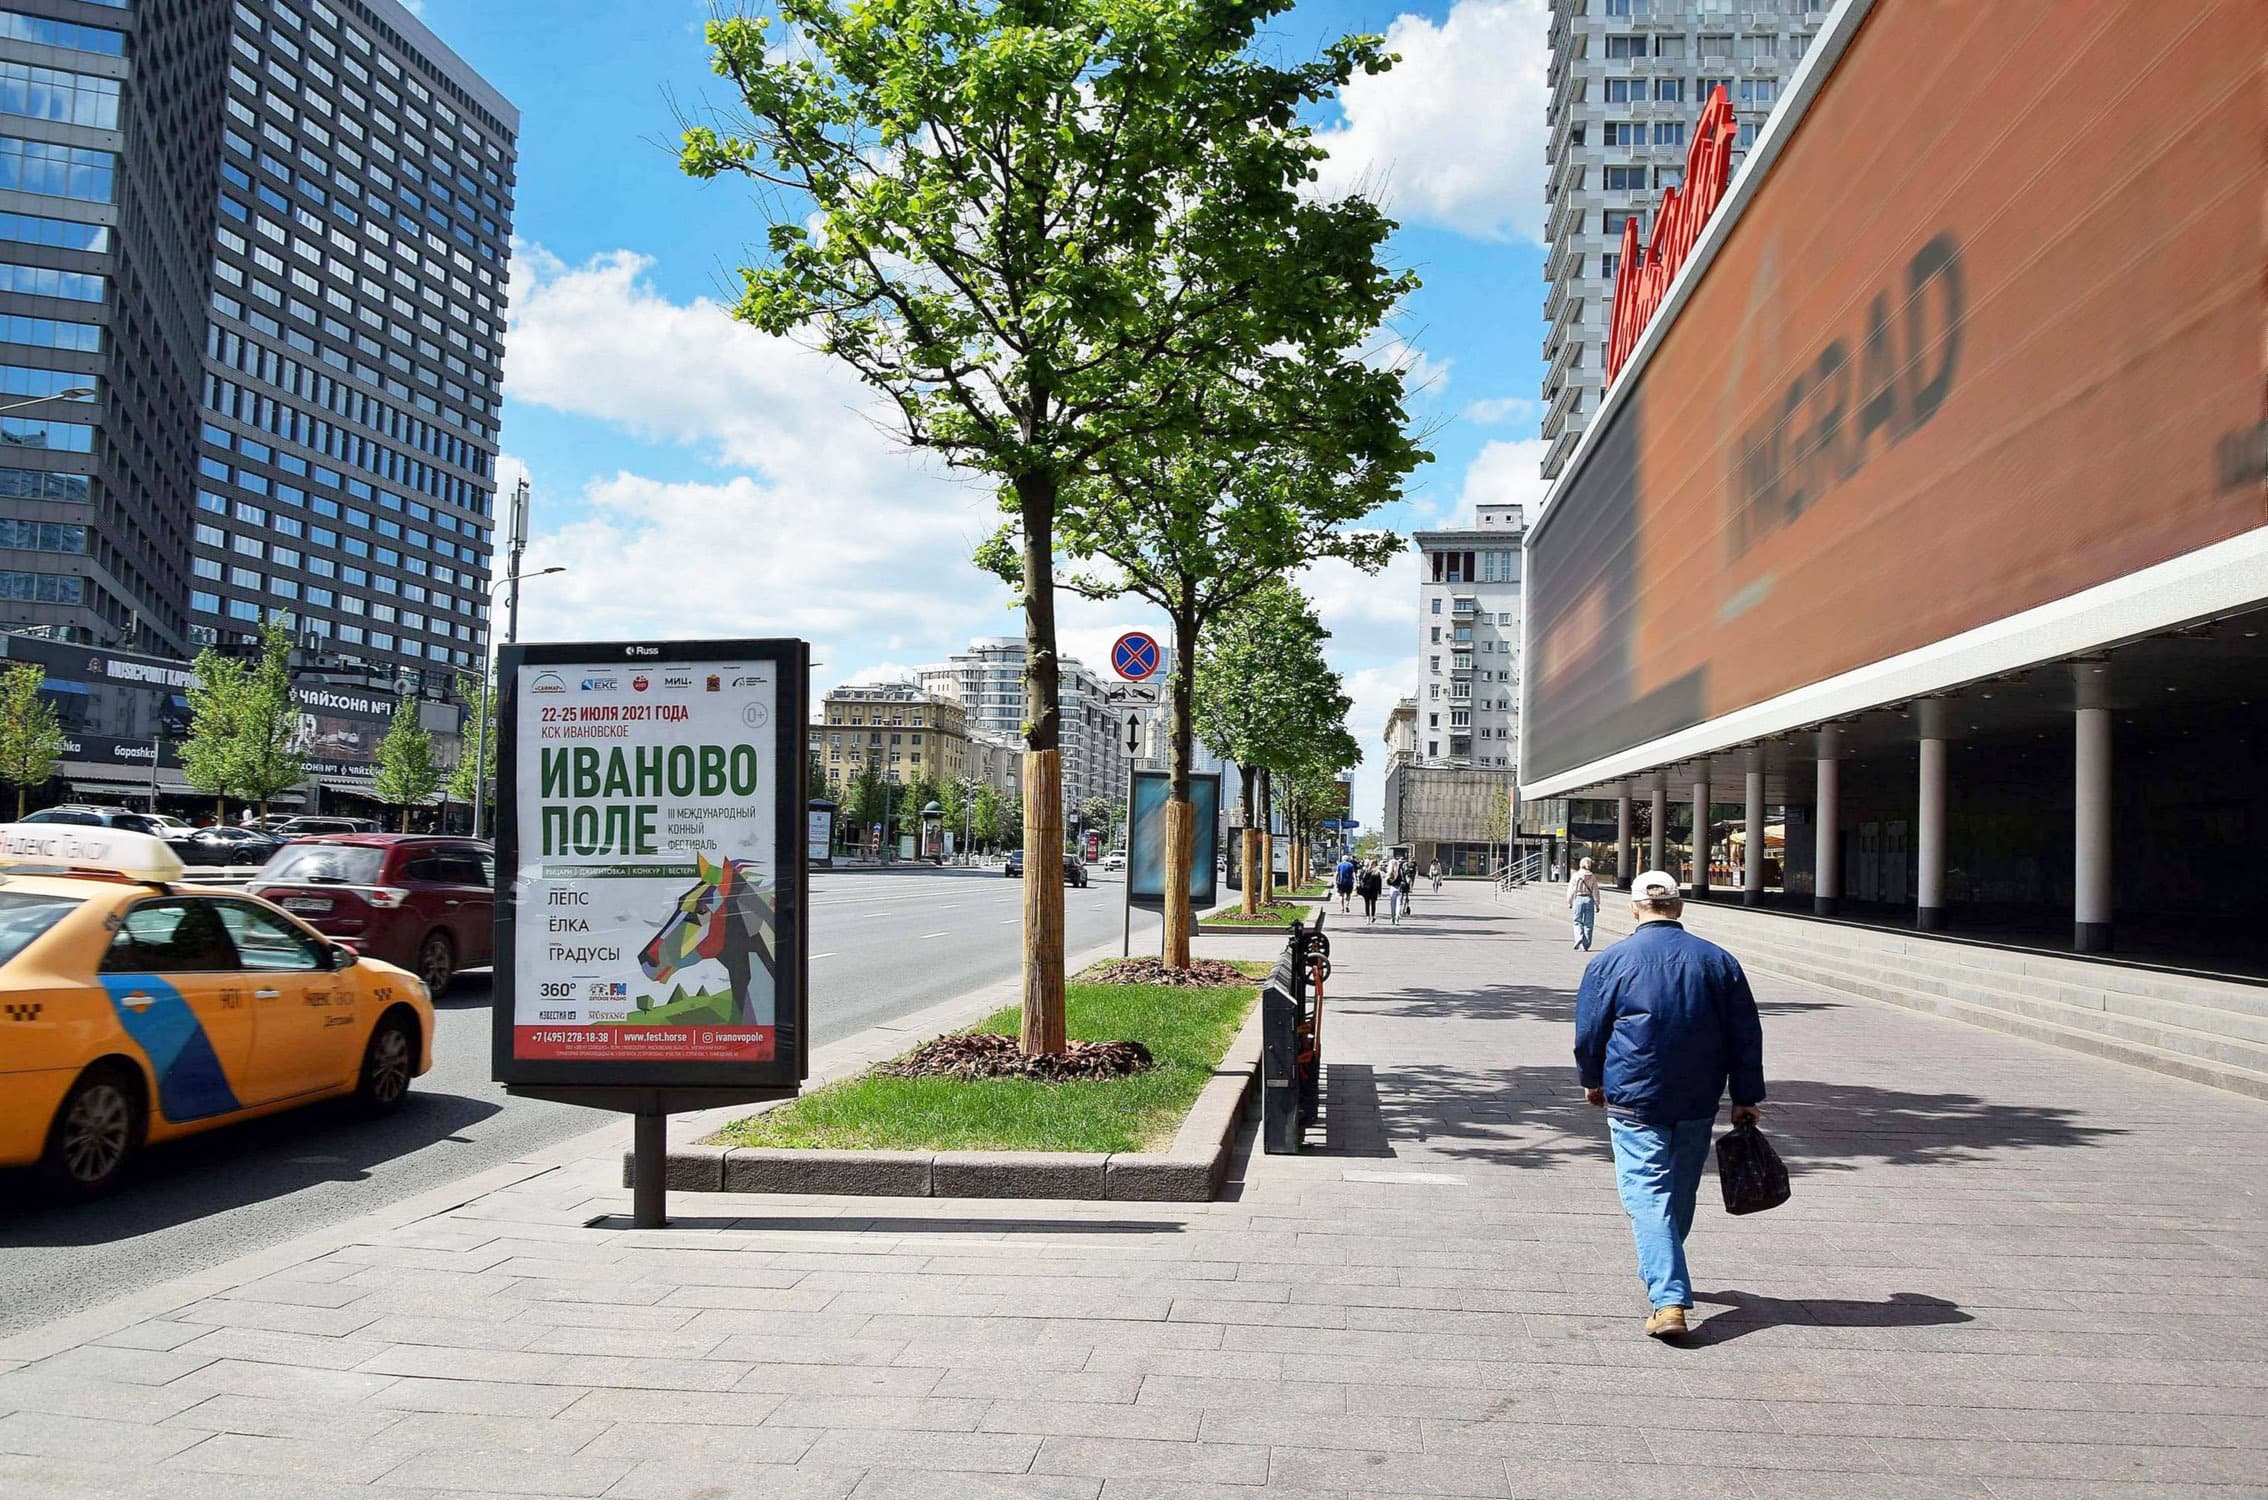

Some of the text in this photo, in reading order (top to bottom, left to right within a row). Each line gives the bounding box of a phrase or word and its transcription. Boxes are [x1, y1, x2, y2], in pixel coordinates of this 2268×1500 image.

[636, 646, 659, 655] Russ
[299, 688, 391, 716] ЧАЙХОНА №1
[542, 705, 688, 722] 22-25 ИЮЛЯ 2021 ГОДА
[747, 707, 765, 723] 0+
[541, 725, 629, 739] КСК ИВАНОВСКОЕ
[541, 744, 758, 798] ИВАНОВО
[677, 806, 756, 820] МЕЖДУНАРОДНЫЙ
[541, 804, 658, 856] ПОЛЕ
[668, 822, 705, 835] КОННЫЙ
[668, 839, 718, 850] ФЕСТИВАЛЬ
[548, 891, 589, 905] ЛЕПС
[549, 915, 590, 932] ЁЛКА
[549, 947, 620, 963] ГРАДУСЫ
[540, 983, 577, 997] 360°
[532, 1031, 764, 1044] +7 (495) 278-18-38 www.fest.horse ivanovopole
